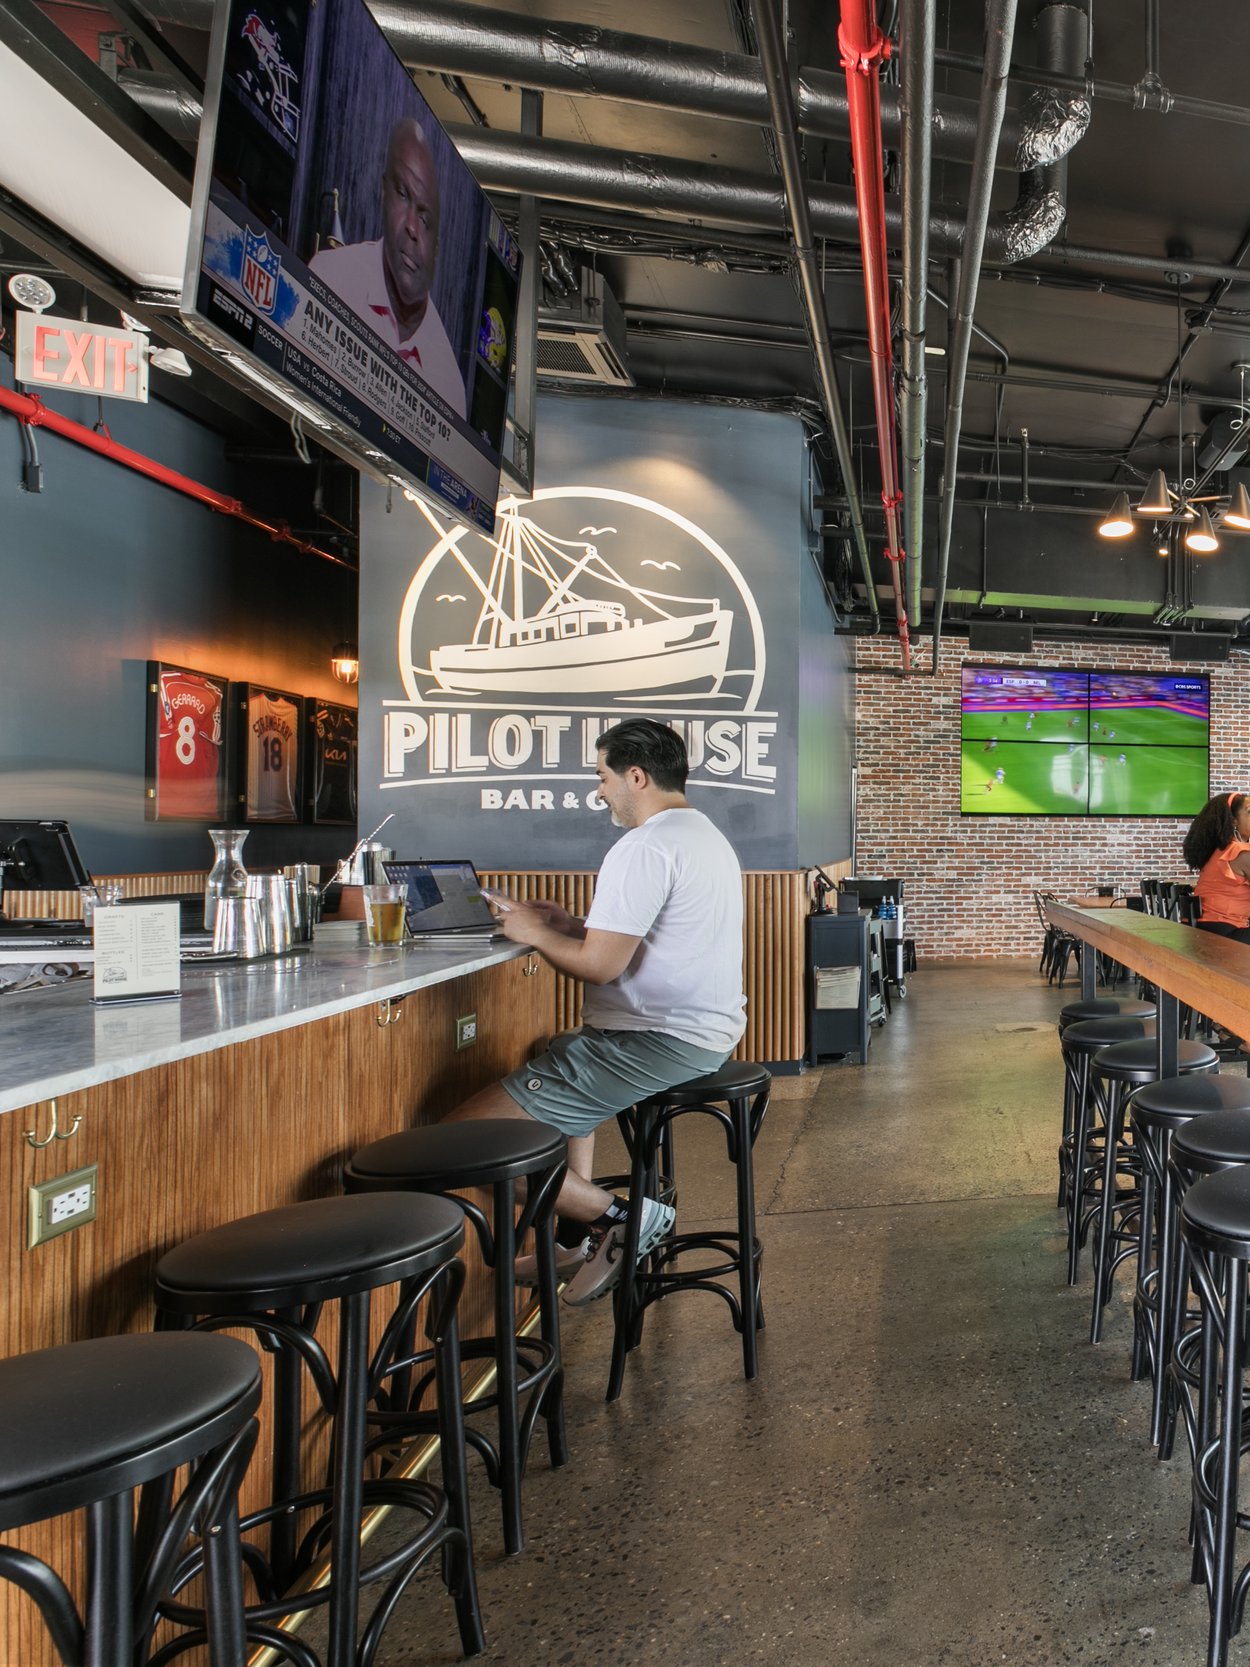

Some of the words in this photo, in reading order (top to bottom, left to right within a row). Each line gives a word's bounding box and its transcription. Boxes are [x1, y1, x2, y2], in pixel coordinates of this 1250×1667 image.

[244, 256, 272, 307] NFL
[32, 325, 134, 393] EXIT
[258, 325, 283, 350] SOCCER
[287, 345, 301, 366] USA
[312, 365, 327, 387] Costa
[304, 297, 332, 336] ANY
[334, 325, 367, 367] ISSUE
[369, 356, 397, 395] WITH
[399, 384, 417, 412] THE
[418, 402, 436, 429] TOP
[437, 419, 450, 442] 10?
[176, 716, 195, 765] 8
[263, 736, 282, 772] 18
[383, 711, 572, 778] PILOT
[582, 717, 777, 783] HUSE
[481, 788, 556, 810] BAR
[563, 791, 579, 809] &
